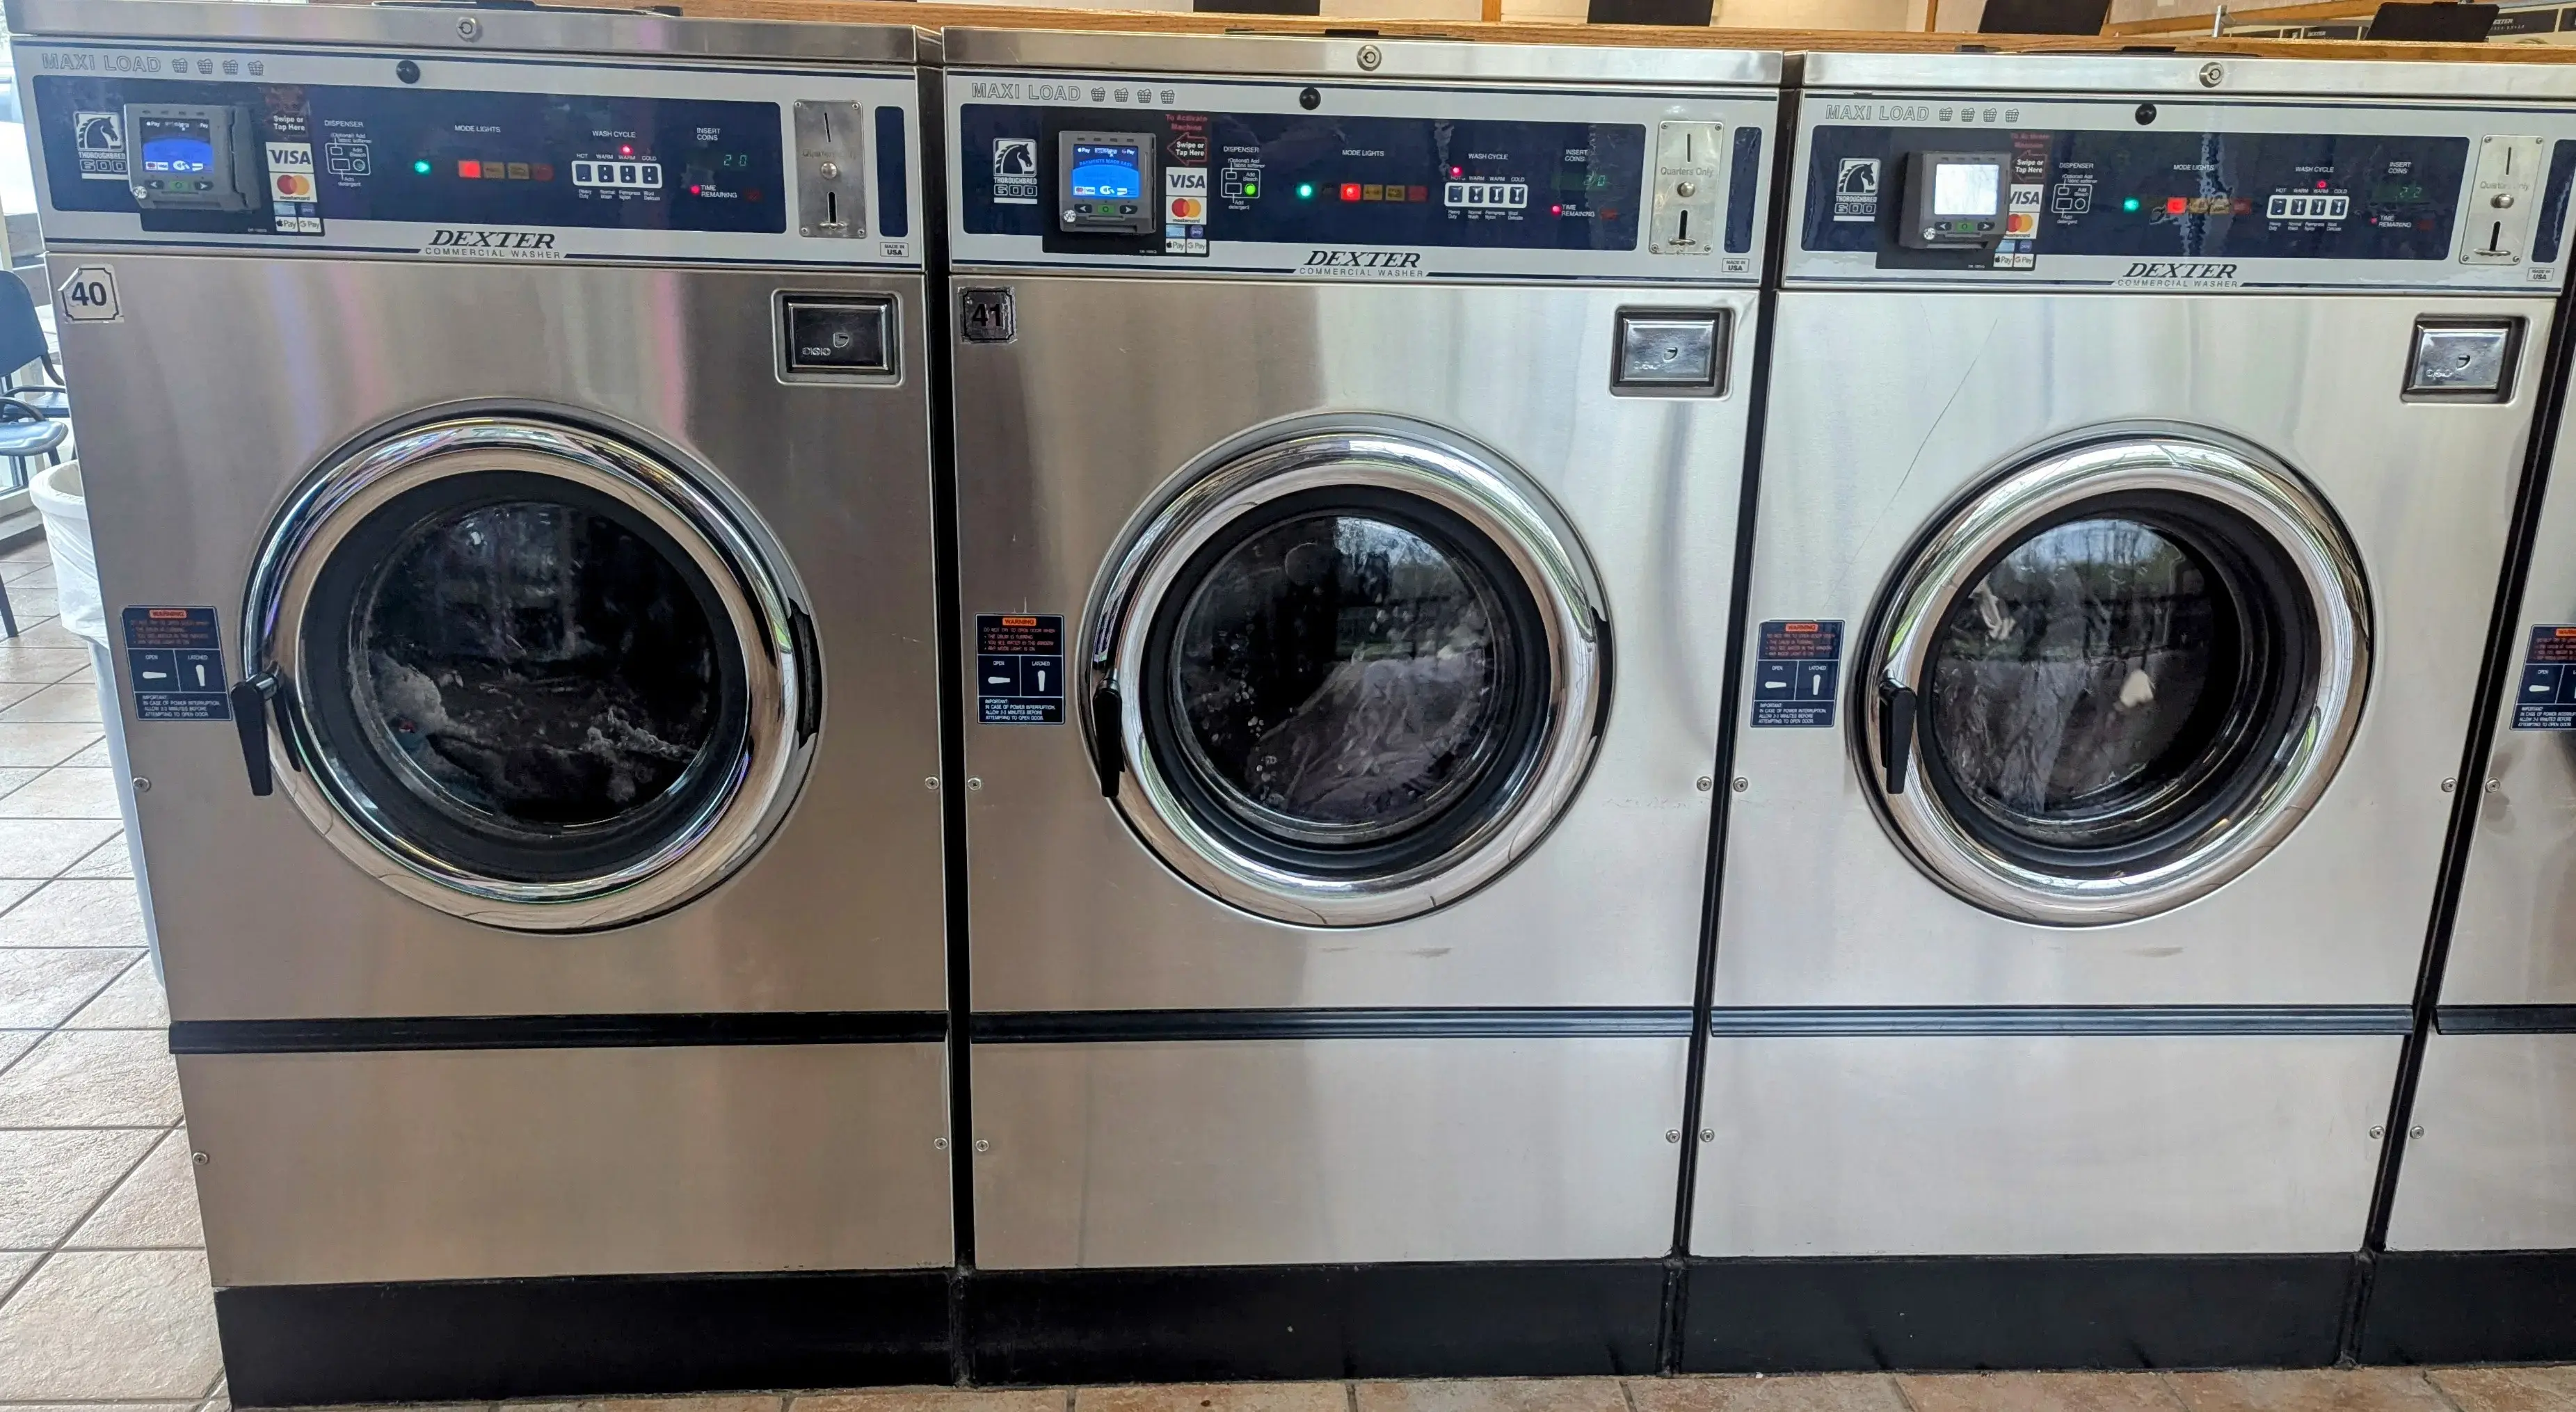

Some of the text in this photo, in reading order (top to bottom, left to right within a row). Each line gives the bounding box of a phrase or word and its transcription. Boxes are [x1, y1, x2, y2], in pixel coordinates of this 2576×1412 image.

[42, 53, 161, 72] MAXI LOAD
[971, 82, 1080, 101] MAXI LOAD
[1825, 104, 1930, 121] MAXI LOAD
[273, 115, 294, 124] Swipe
[274, 123, 287, 131] Tap
[269, 149, 312, 165] VISA
[1661, 166, 1714, 177] Quarters Only
[1167, 174, 1206, 188] VISA
[284, 219, 297, 229] Pay
[307, 219, 320, 229] Pay
[429, 230, 556, 249] DEXTER
[1173, 241, 1185, 250] Pay
[1194, 242, 1205, 250] Pay
[425, 247, 560, 259] COMMERCIAL WASHER
[1304, 250, 1421, 268] DEXTER
[2001, 256, 2012, 264] Pay
[1299, 267, 1372, 276] COMMERCIAL
[2122, 262, 2237, 278] DEXTER
[2118, 279, 2188, 287] COMMERCIAL
[71, 281, 107, 307] 40
[972, 303, 1001, 327] 41
